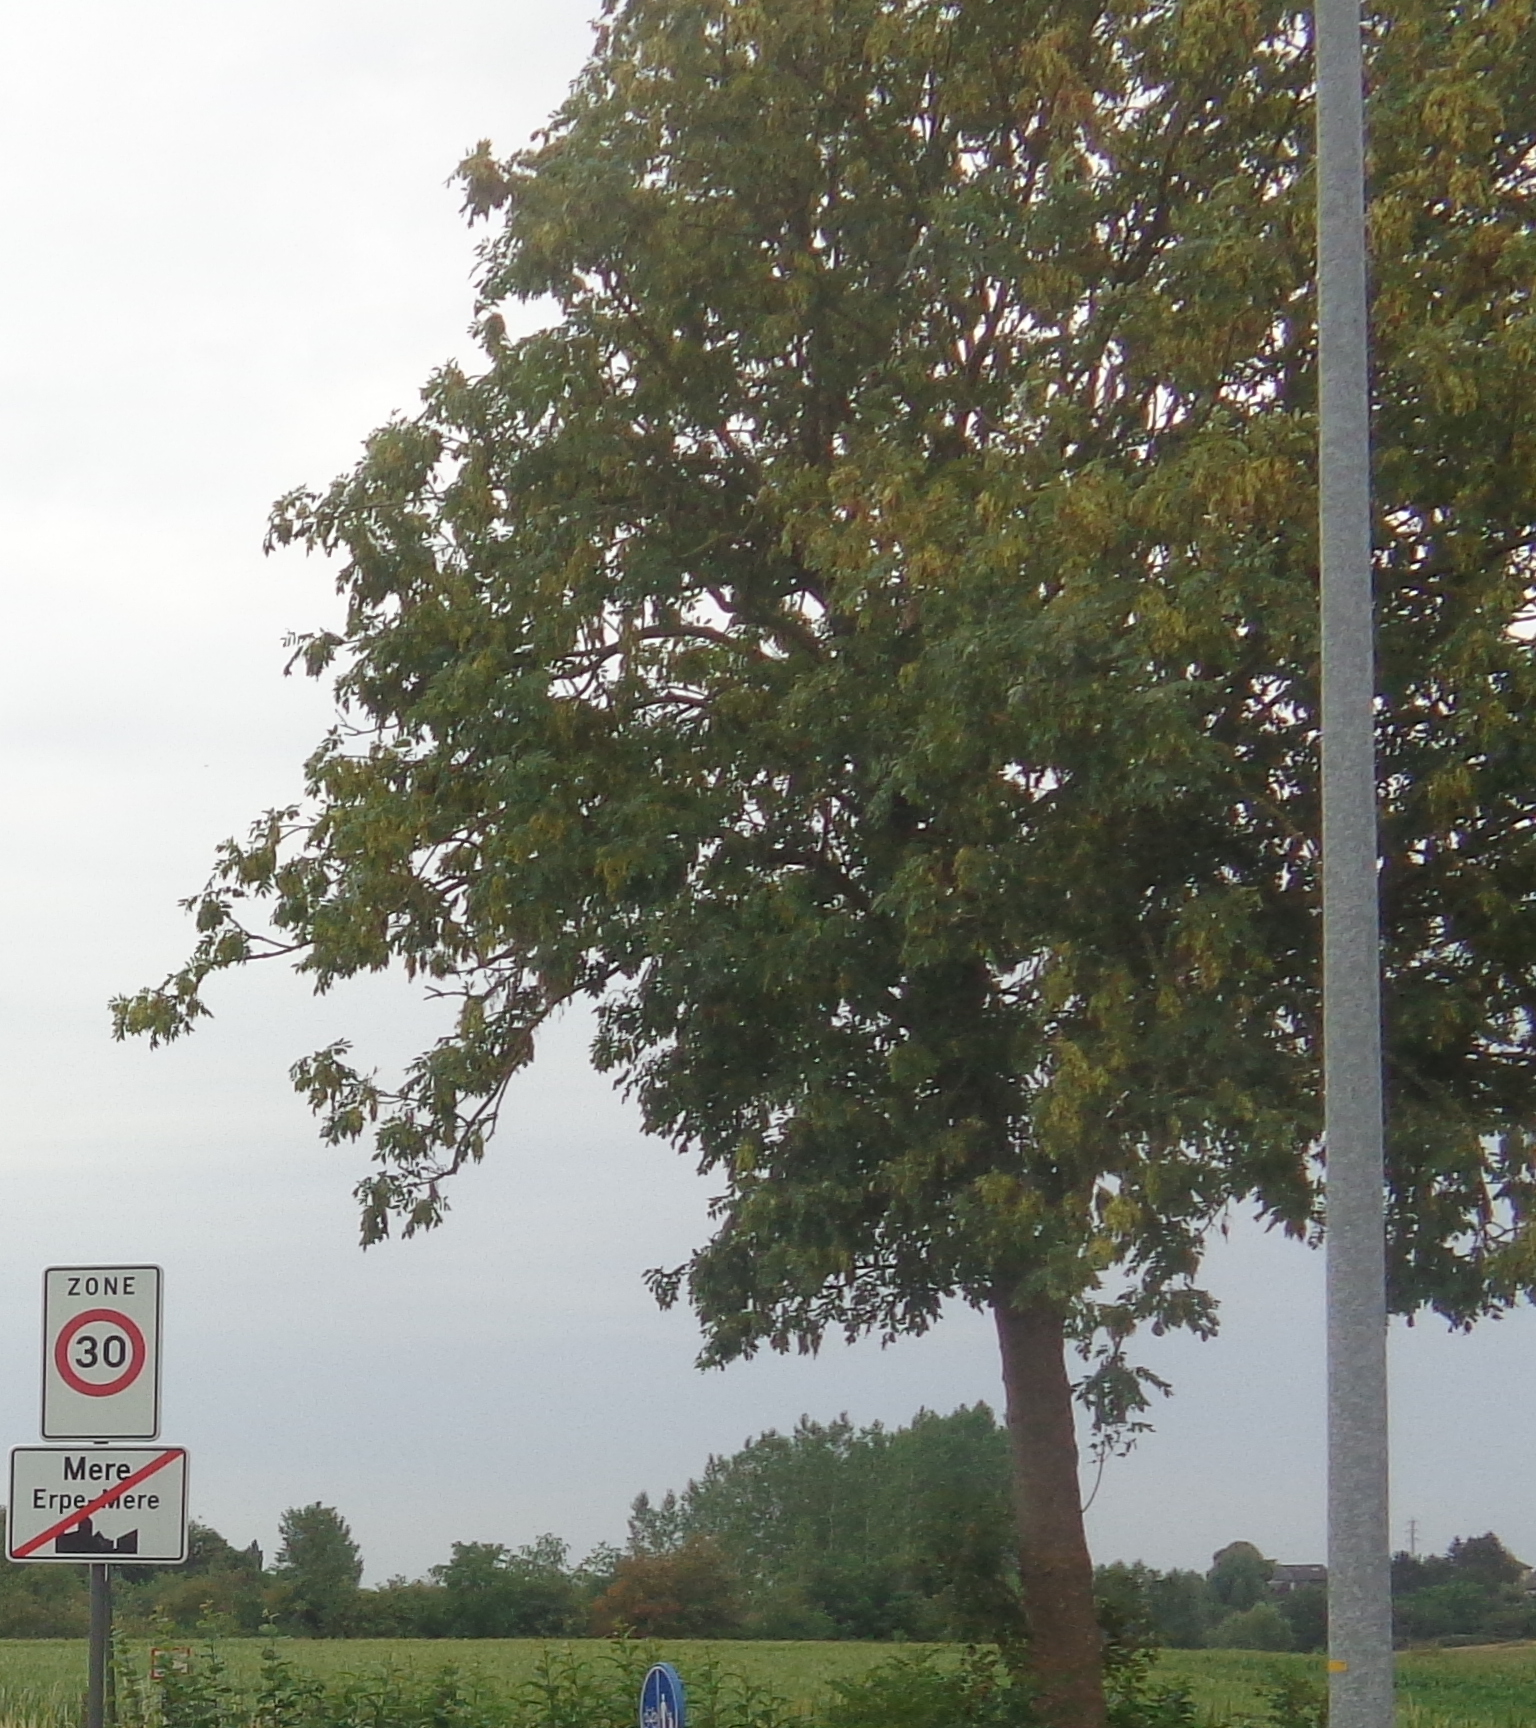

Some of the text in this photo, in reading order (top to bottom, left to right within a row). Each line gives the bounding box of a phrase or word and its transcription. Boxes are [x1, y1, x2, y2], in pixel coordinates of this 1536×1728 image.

[67, 1276, 135, 1296] ZONE
[75, 1334, 126, 1368] 30
[63, 1456, 131, 1481] Mere
[33, 1488, 160, 1514] Erpe-Mere
